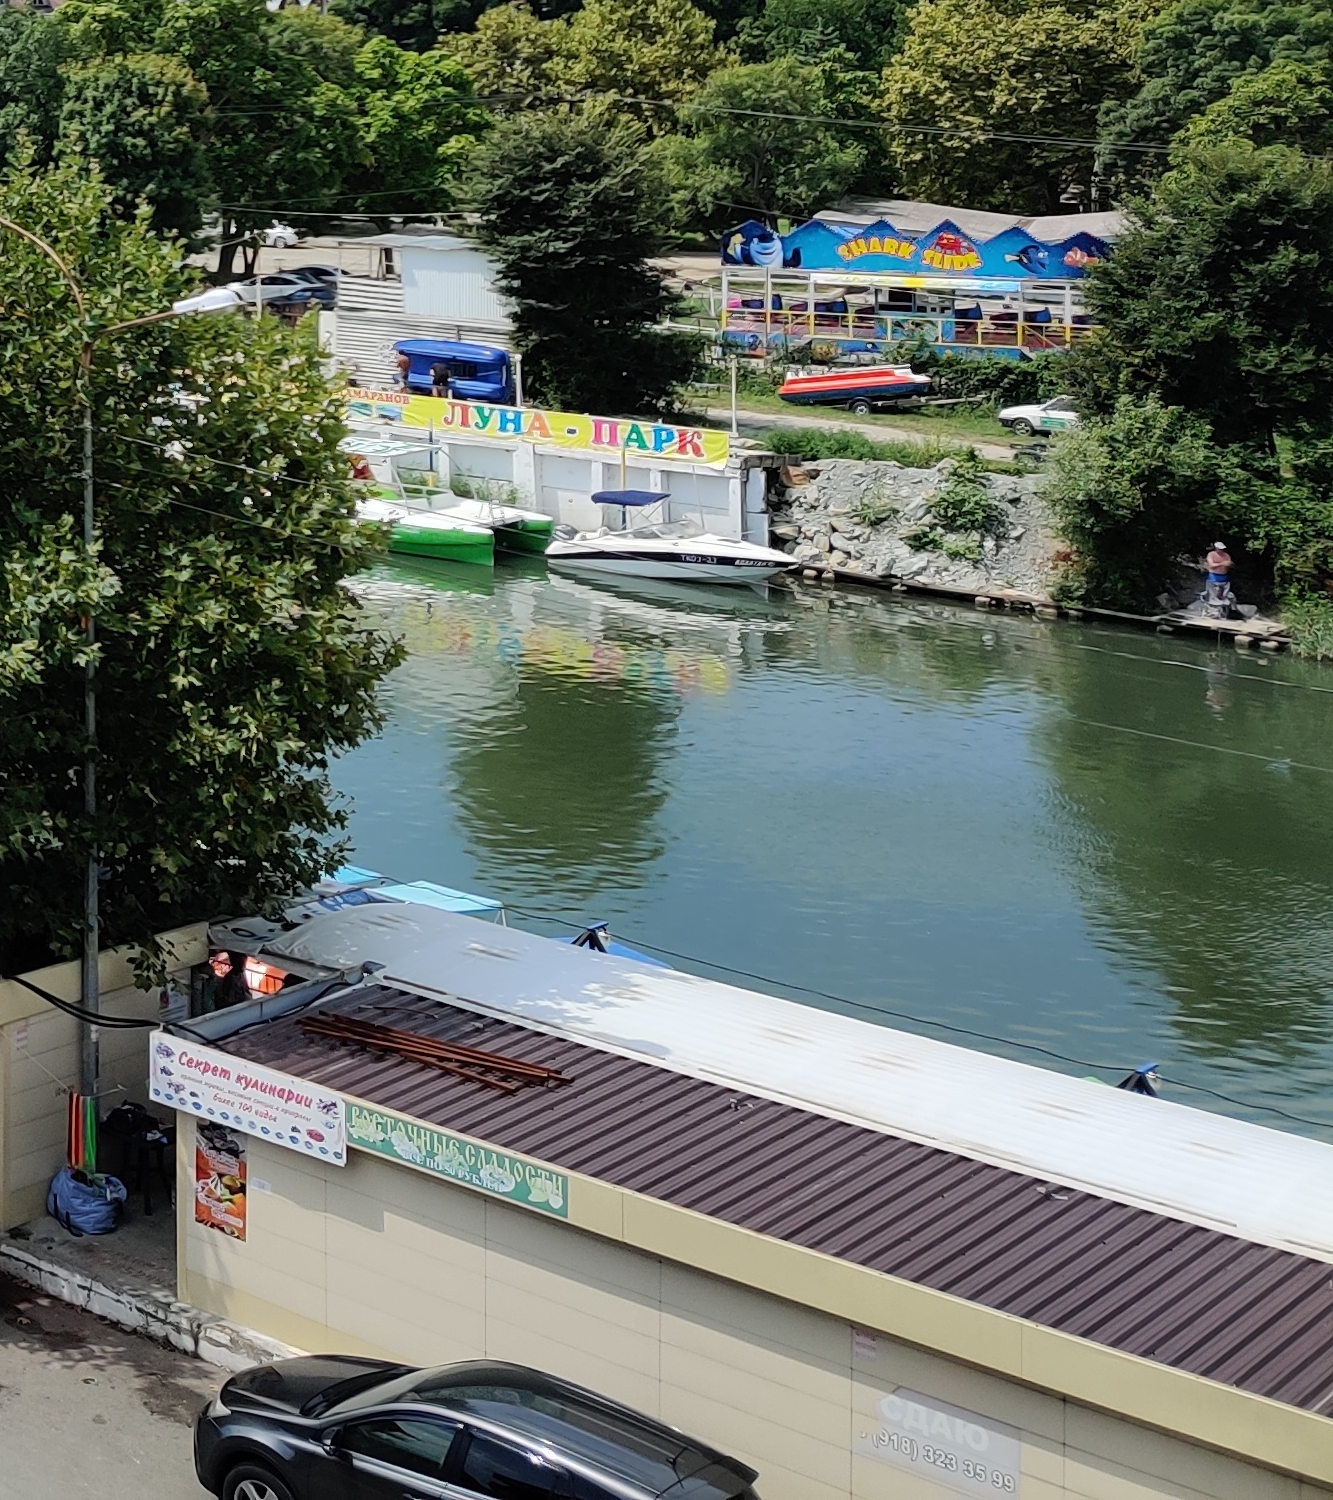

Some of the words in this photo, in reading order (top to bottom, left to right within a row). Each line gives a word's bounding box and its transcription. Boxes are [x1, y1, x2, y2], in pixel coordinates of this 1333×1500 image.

[836, 236, 919, 262] SHARK
[921, 248, 983, 271] SLIDE
[347, 388, 410, 405] АМАРАНОВ
[443, 400, 554, 438] ЛУНА
[591, 418, 706, 458] ПАРК
[178, 1050, 231, 1080] Секрет
[235, 1072, 313, 1109] кулинарии
[238, 1101, 253, 1113] 100
[351, 1105, 460, 1159] ВОСТОЧНЫЕ
[465, 1144, 563, 1198] СЛАДОСТИ
[425, 1157, 441, 1171] ПО
[882, 1399, 989, 1450] СДАЮ
[873, 1429, 918, 1461] (918)
[923, 1445, 957, 1471] 323
[962, 1460, 986, 1482] 35
[991, 1470, 1015, 1493] 99
